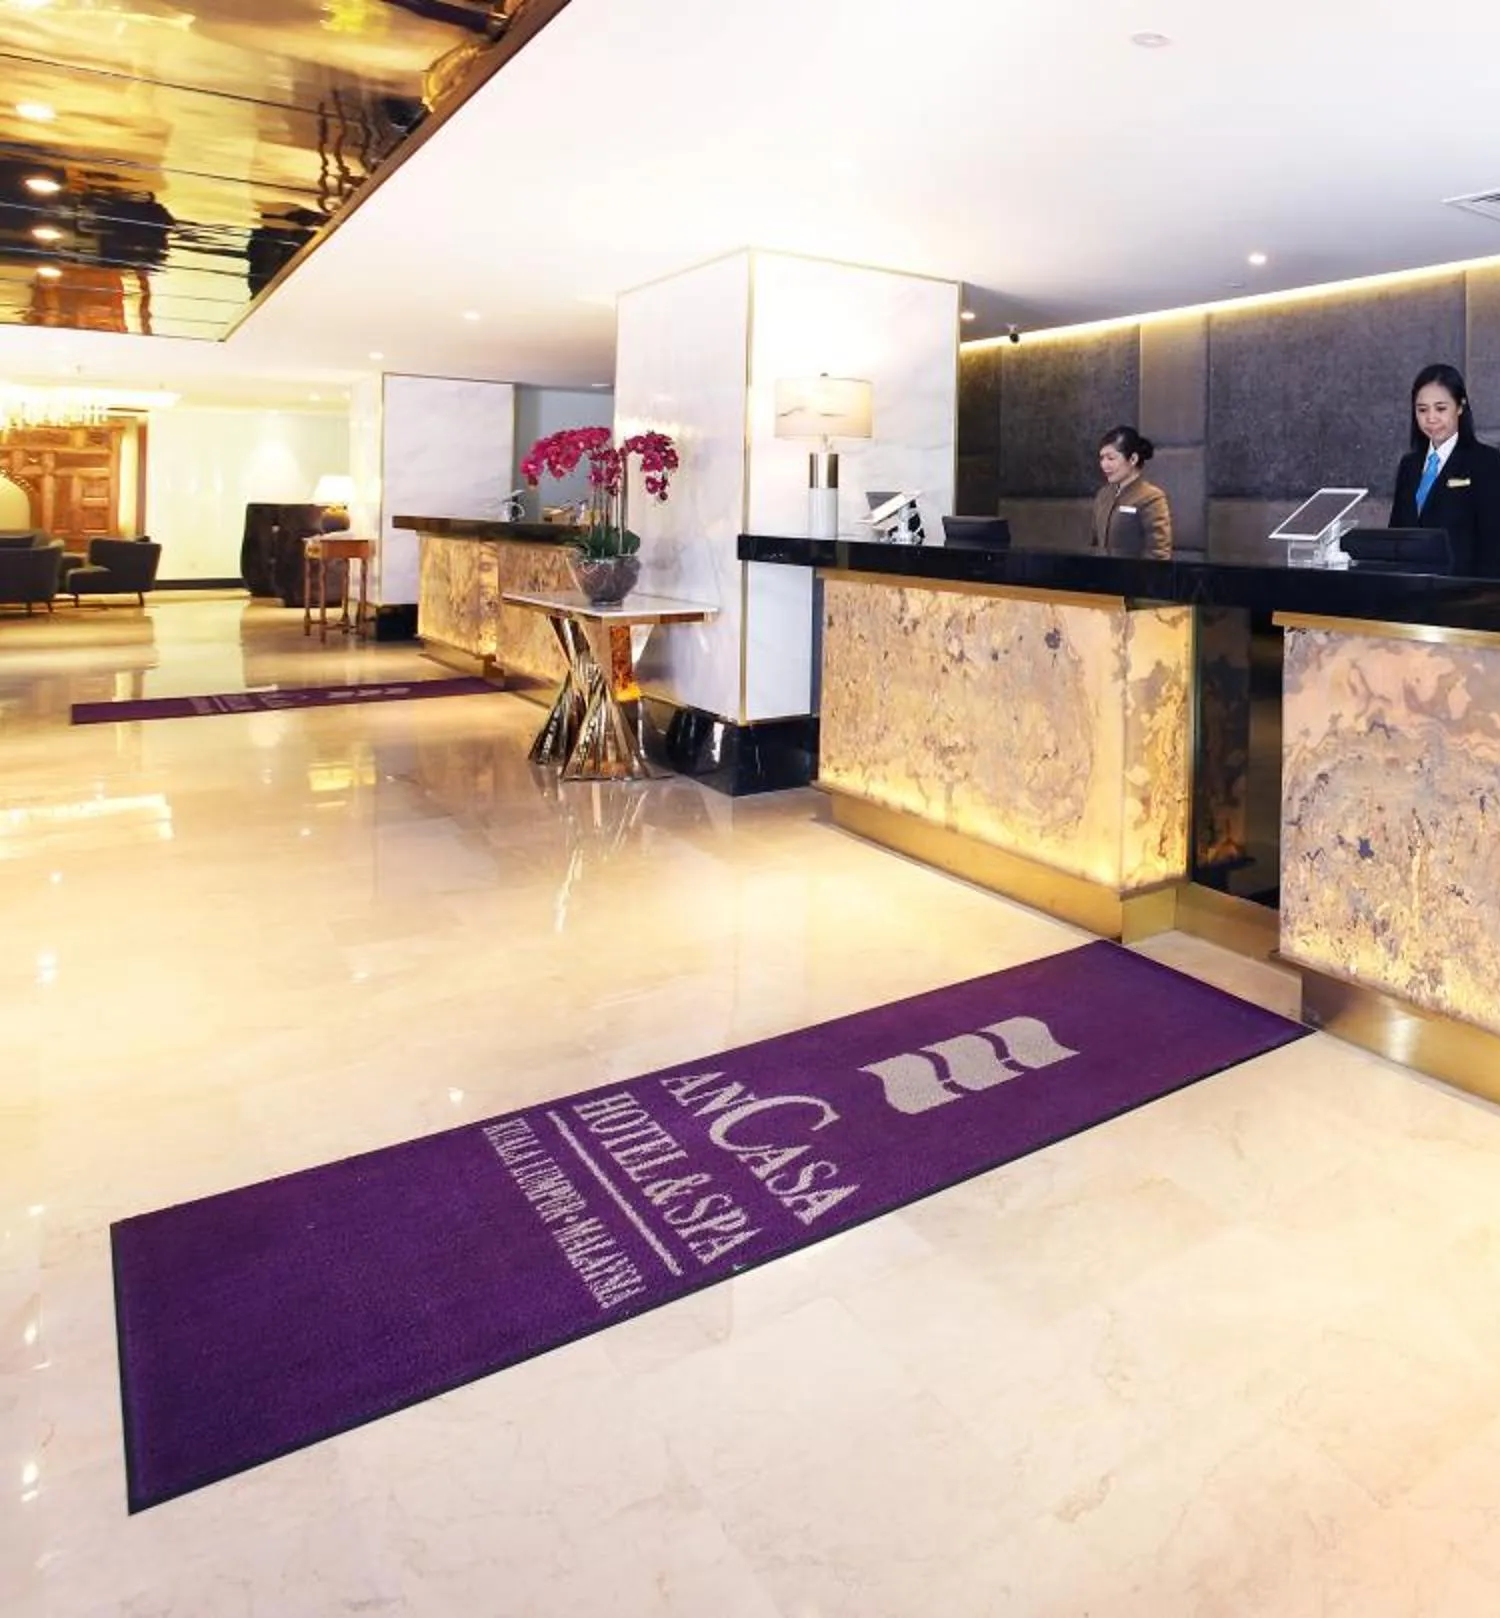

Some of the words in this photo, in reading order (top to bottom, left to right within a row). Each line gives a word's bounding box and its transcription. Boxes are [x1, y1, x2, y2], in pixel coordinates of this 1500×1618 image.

[482, 1118, 544, 1166] KUALA
[573, 1092, 688, 1183] HOTEL
[643, 1173, 711, 1206] &
[663, 1193, 763, 1265] SPA
